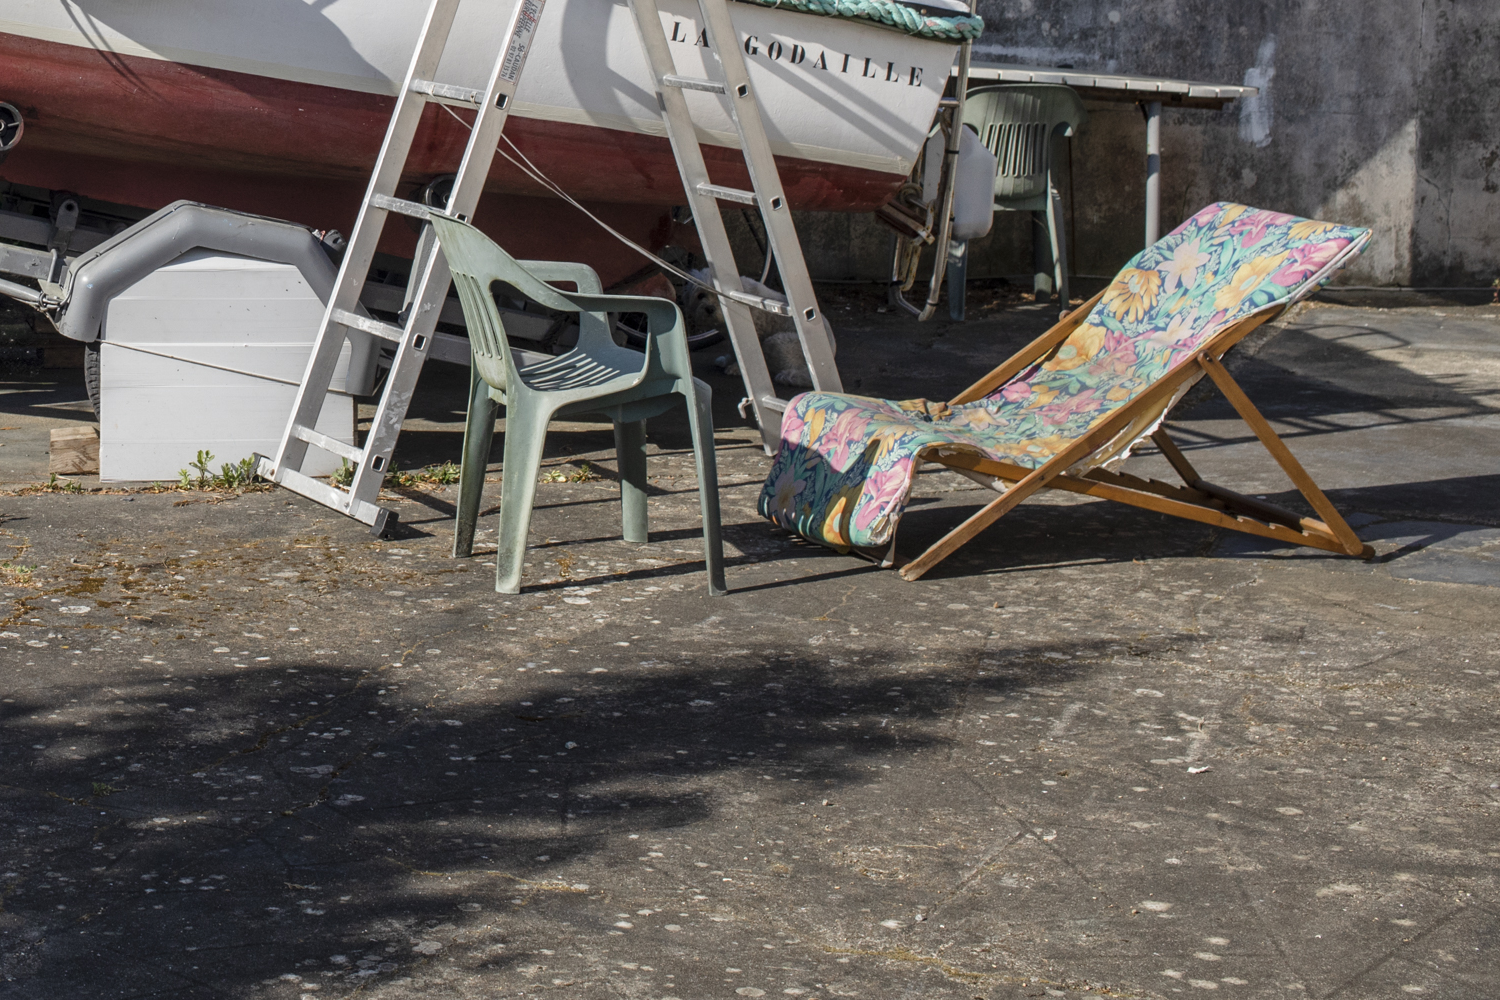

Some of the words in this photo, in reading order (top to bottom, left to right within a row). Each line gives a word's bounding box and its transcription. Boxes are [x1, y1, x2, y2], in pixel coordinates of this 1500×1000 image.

[523, 2, 539, 33] L'ECELLE
[670, 21, 710, 48] LA
[744, 35, 923, 87] GODAILLE
